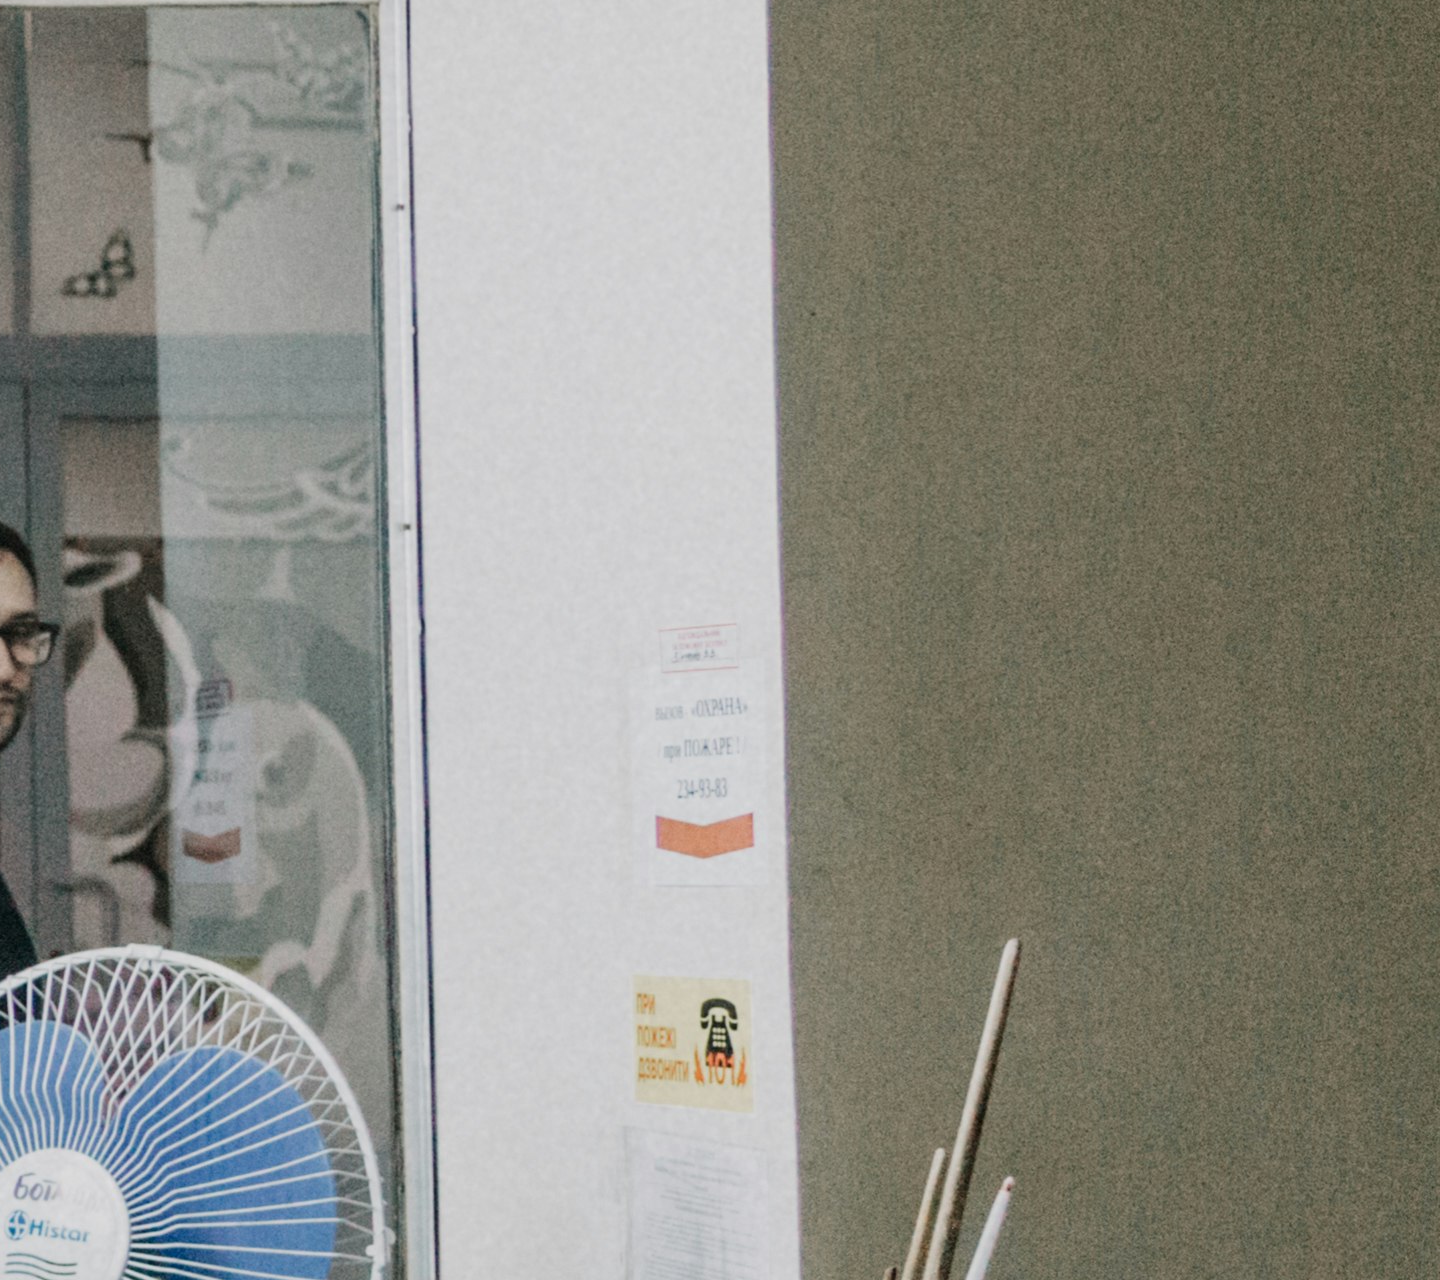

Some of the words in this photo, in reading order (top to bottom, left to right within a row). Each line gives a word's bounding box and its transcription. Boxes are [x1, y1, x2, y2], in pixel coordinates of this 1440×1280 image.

[637, 993, 655, 1015] ПРИ
[638, 1057, 689, 1082] ДЗВОНИТИ
[706, 1051, 735, 1085] 101
[29, 1219, 90, 1242] Histar
